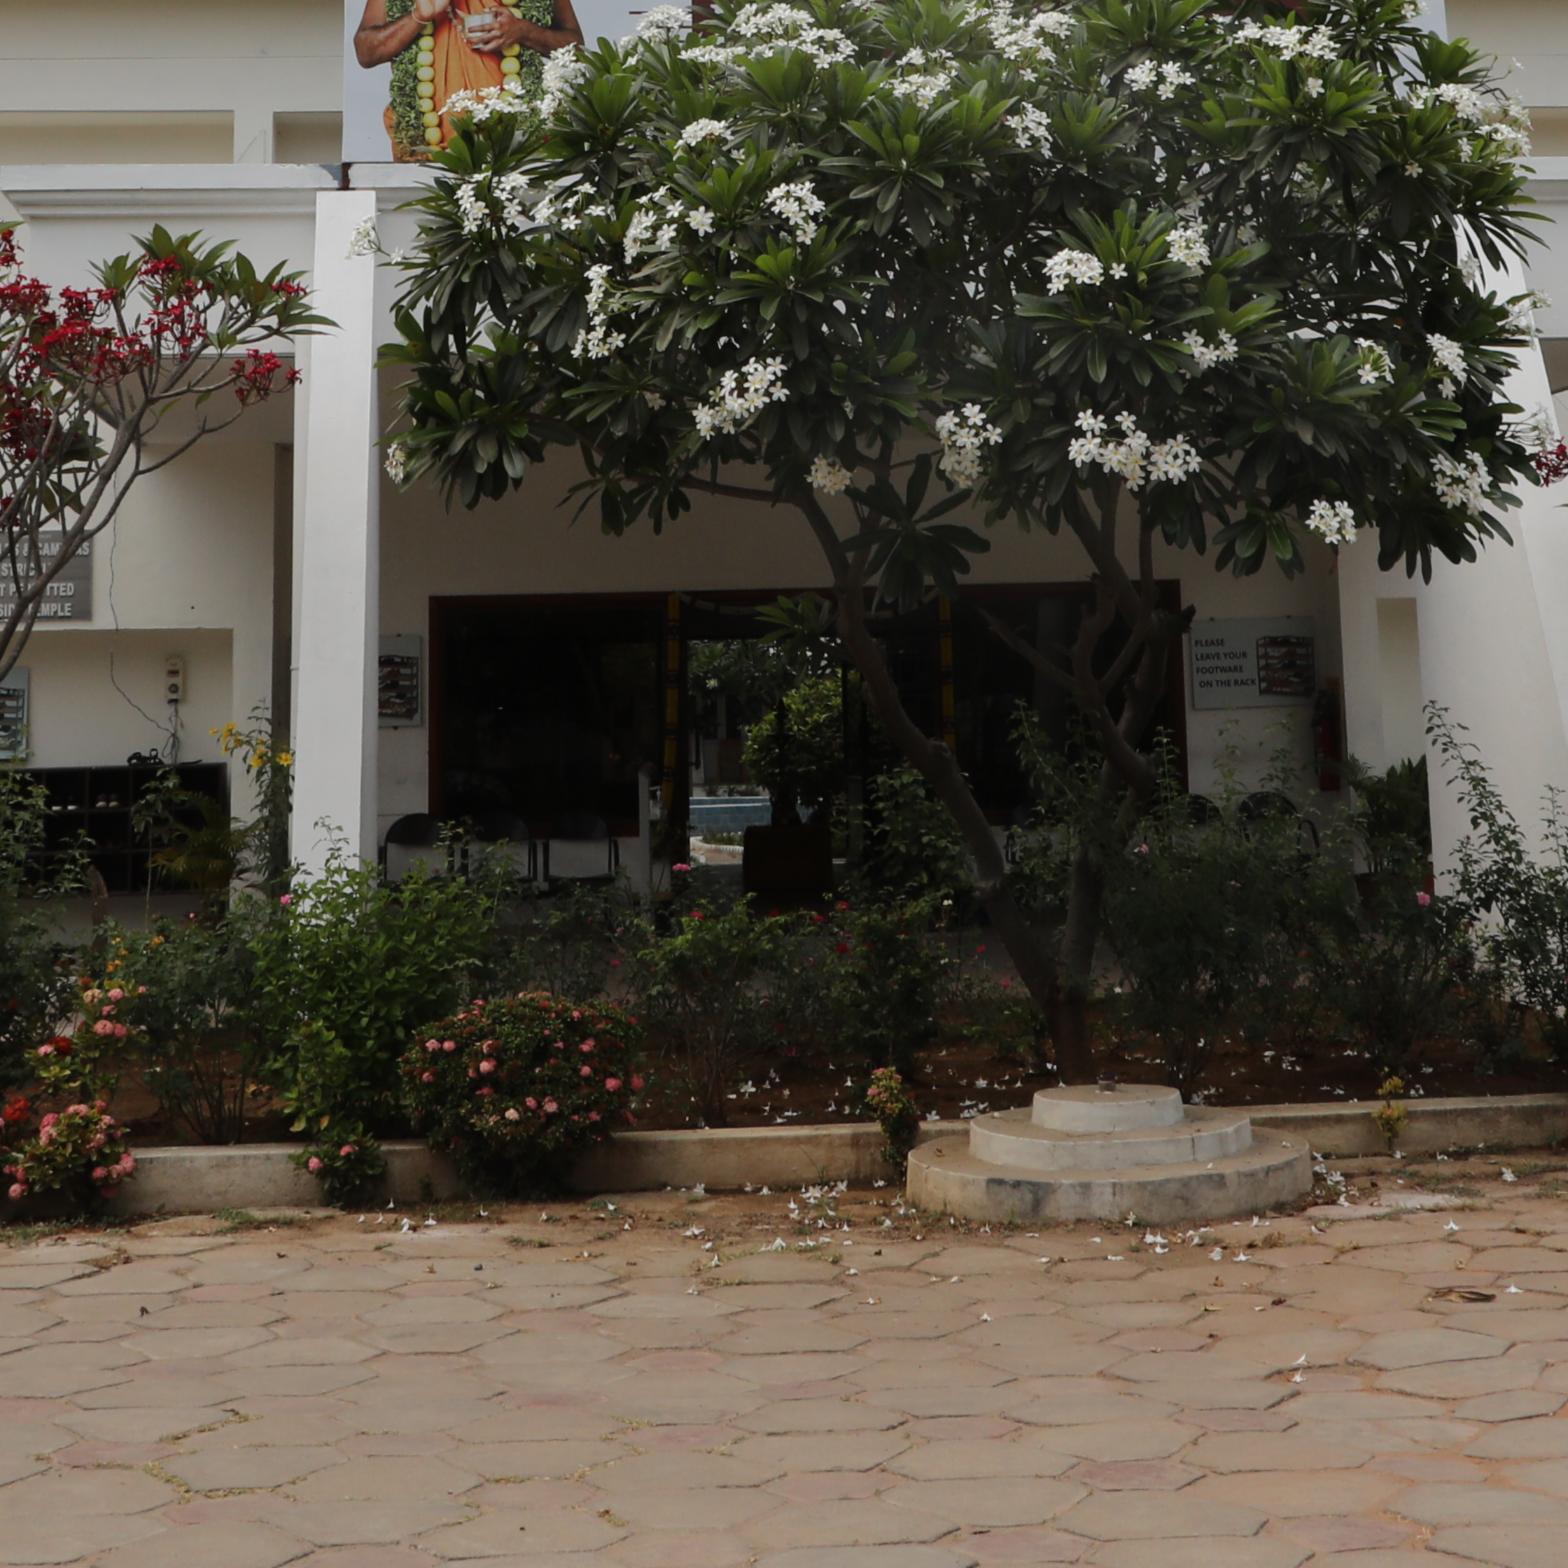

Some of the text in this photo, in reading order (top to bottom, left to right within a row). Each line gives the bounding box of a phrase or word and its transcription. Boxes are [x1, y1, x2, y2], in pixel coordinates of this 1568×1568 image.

[1194, 638, 1225, 648] PLEASE
[1195, 651, 1248, 662] LEAVE YOUR
[1199, 678, 1257, 689] ON THE RACK
